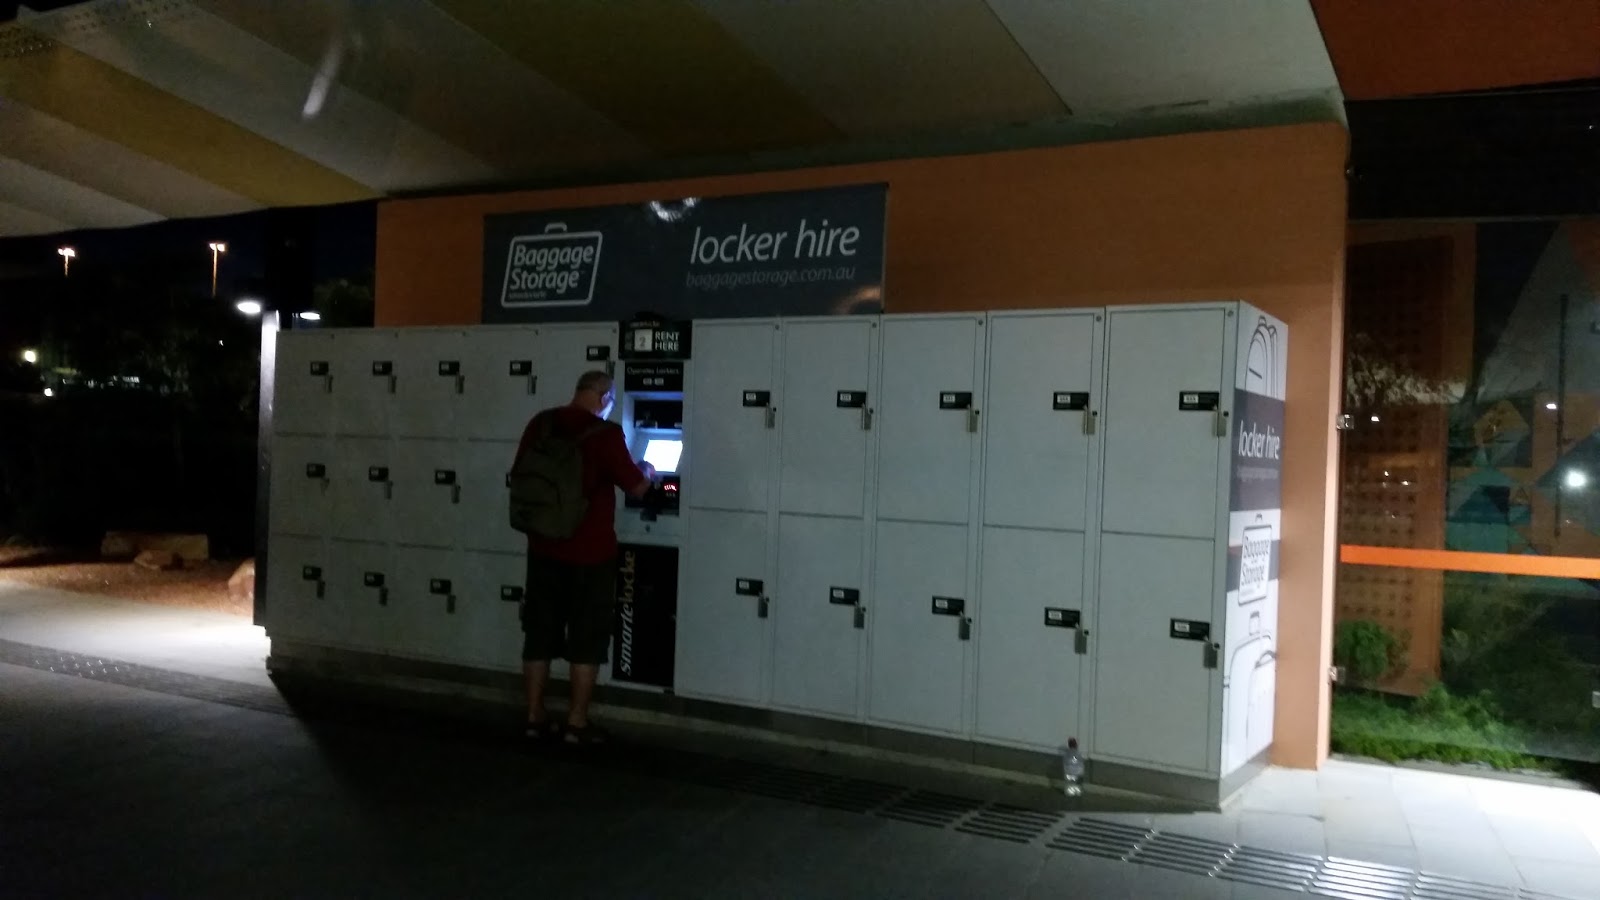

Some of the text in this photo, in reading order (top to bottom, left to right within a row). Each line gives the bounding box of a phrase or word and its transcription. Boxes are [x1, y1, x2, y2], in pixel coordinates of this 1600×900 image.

[690, 218, 861, 264] locker hire
[513, 243, 595, 270] Baggage
[509, 267, 580, 295] Storage
[686, 265, 856, 290] baggagestorage.com.au
[654, 330, 680, 341] RENT
[654, 341, 680, 352] HERE
[1238, 419, 1281, 460] locker hire
